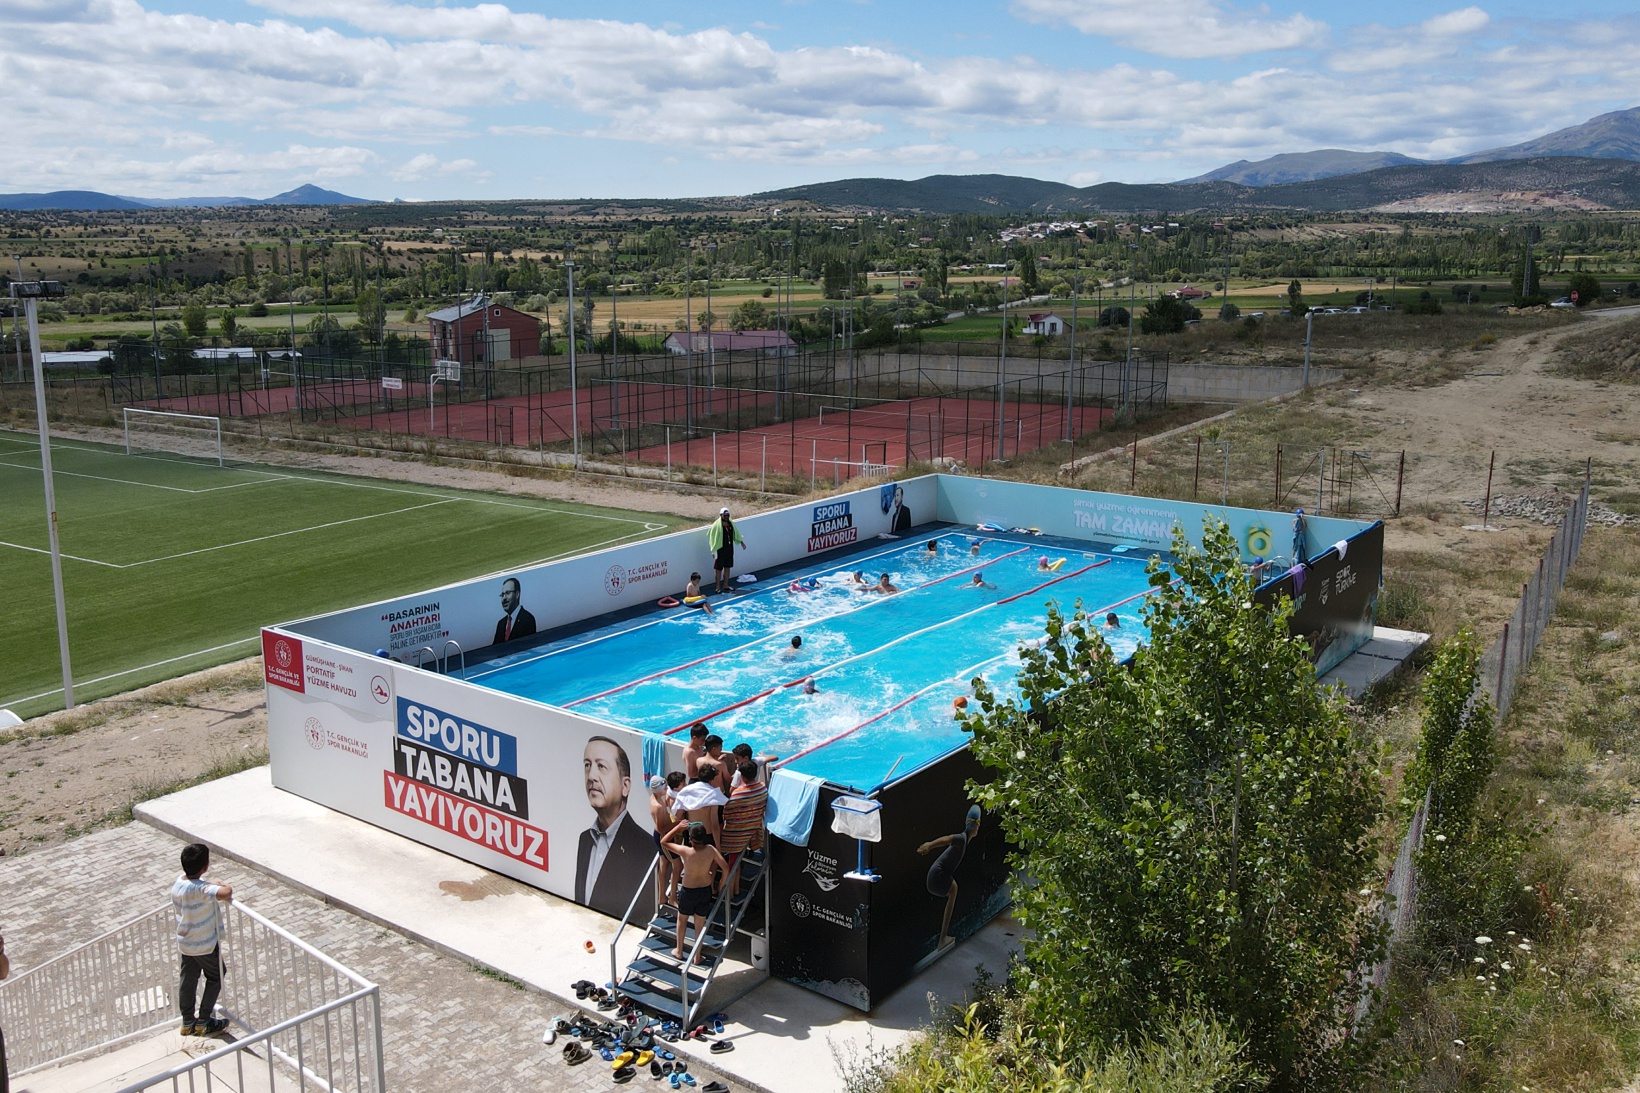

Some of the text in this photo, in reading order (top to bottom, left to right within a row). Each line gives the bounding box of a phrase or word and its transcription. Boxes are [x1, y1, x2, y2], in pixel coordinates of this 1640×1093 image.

[816, 504, 846, 520] SPORU
[814, 516, 849, 536] TABANA
[1072, 510, 1175, 540] TAM ZAMAN
[809, 529, 856, 551] YAYIYORUZ
[628, 576, 641, 584] SPOR
[390, 613, 440, 633] ANAHTARI
[306, 655, 336, 668] GÜMÜŞHANE
[306, 665, 335, 679] PORTATİF
[307, 675, 357, 697] YÜZME HAVUZU
[327, 730, 335, 739] T.C.
[360, 741, 368, 750] VE
[406, 705, 500, 767] SPORU
[327, 740, 369, 759] SPOR BAKANLIĞI
[401, 744, 517, 812] TABANA
[387, 775, 544, 866] YAYIYORUZ
[807, 848, 838, 866] Yüzme
[812, 911, 825, 919] SPOR
